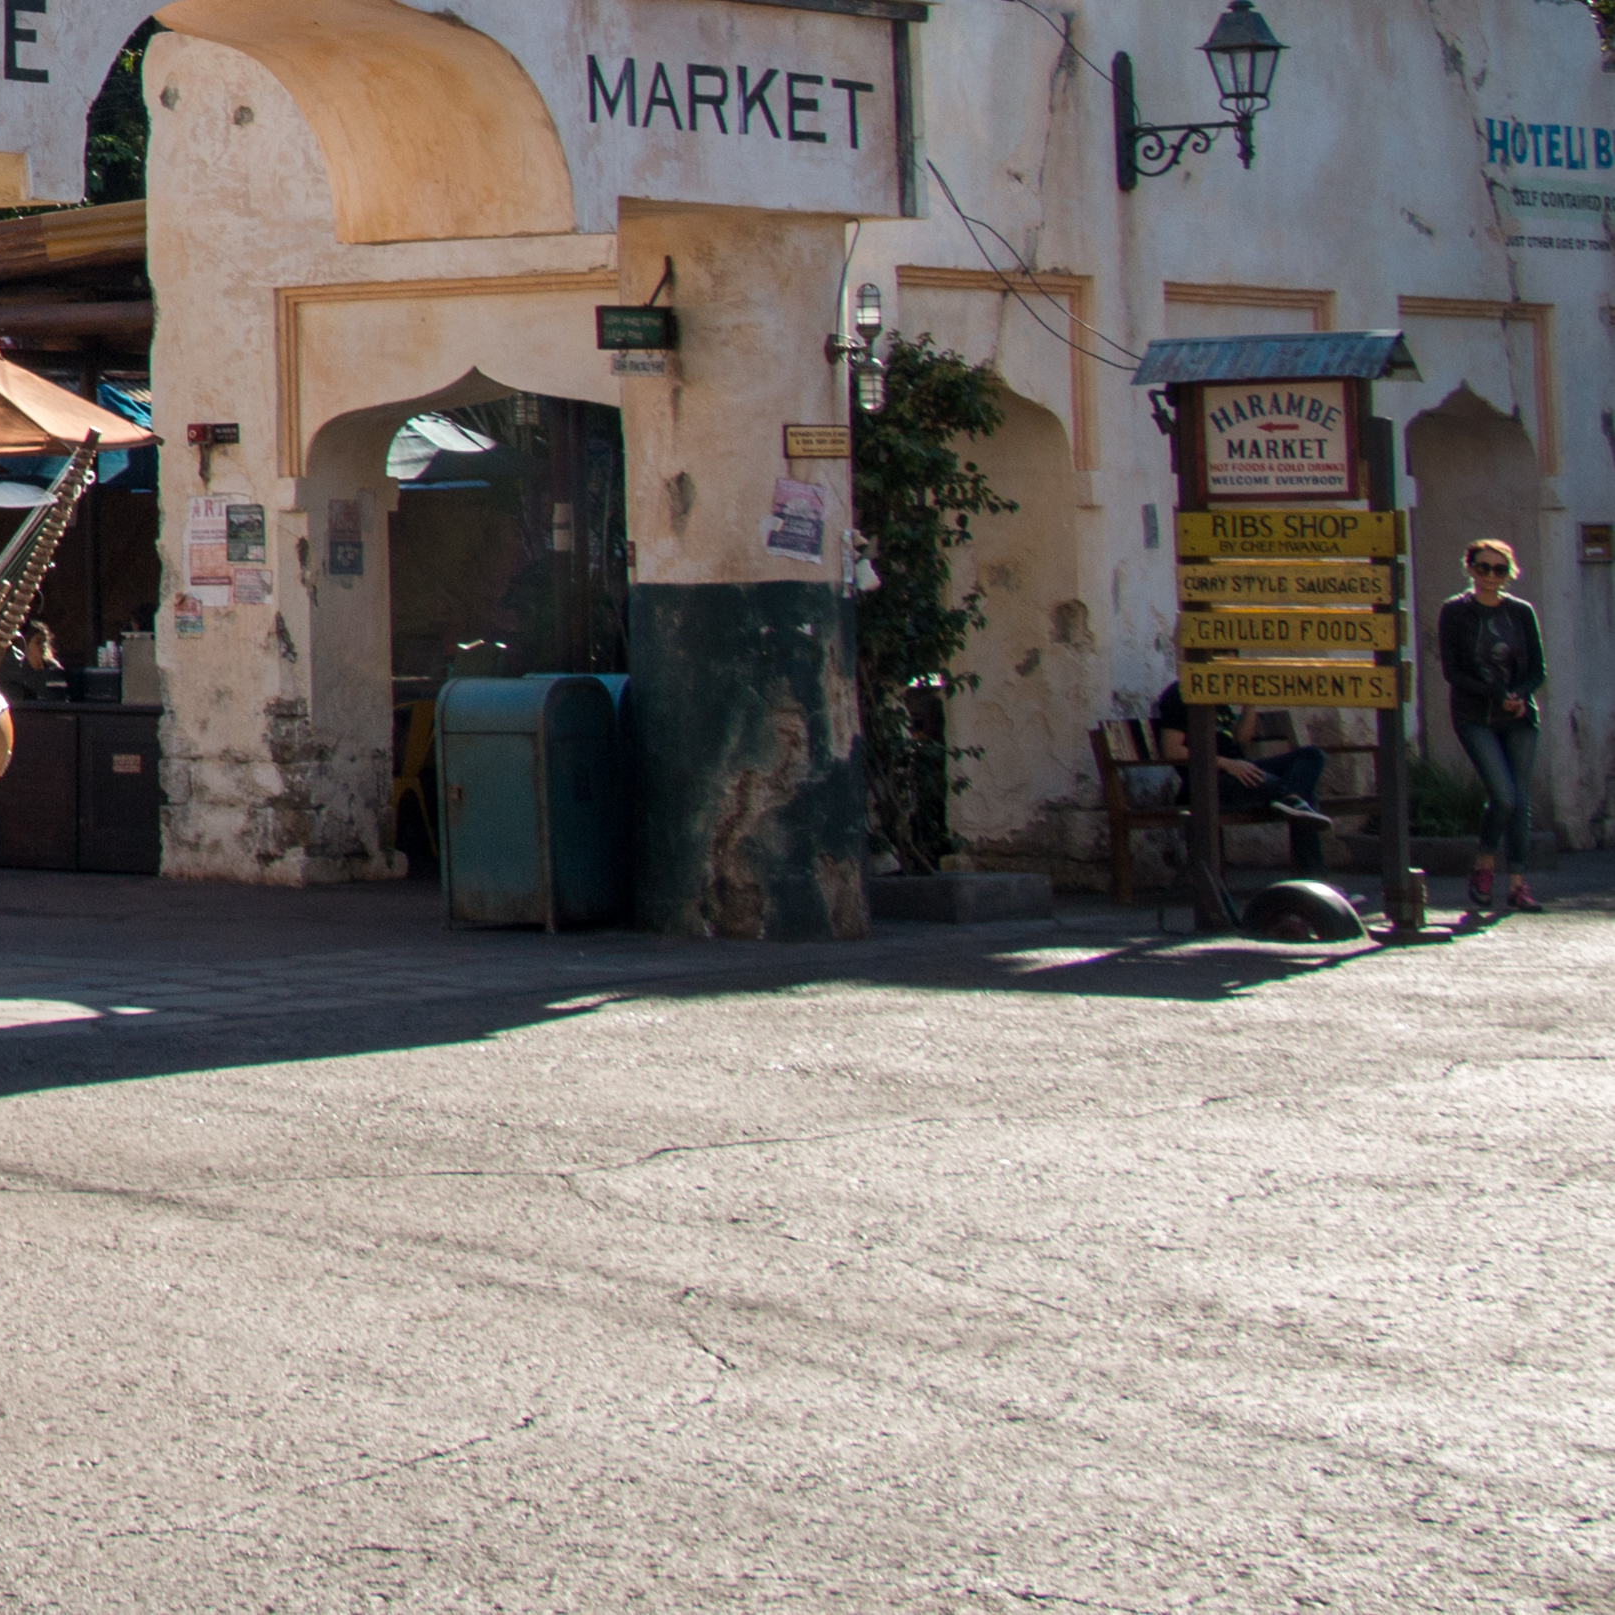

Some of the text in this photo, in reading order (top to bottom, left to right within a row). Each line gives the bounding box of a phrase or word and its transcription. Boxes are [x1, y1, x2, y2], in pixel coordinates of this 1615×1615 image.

[586, 53, 875, 150] MARKET
[1485, 117, 1588, 170] HOTELI
[1512, 186, 1538, 206] SELF
[1541, 191, 1602, 212] CONTAINED
[1209, 392, 1342, 433] HARAMBE
[1226, 439, 1327, 459] MARKET
[1210, 463, 1229, 472] HOT
[1232, 463, 1266, 472] FOODS
[1277, 463, 1305, 473] COLD
[1308, 463, 1346, 473] DRINKS
[1211, 476, 1345, 486] WELCOME EVERYBODY
[1212, 515, 1358, 539] RIBS SHOP
[1219, 540, 1341, 553] BY CHEF MWANGA
[1184, 576, 1382, 594] CURRY STYLE SAUSAGES
[1197, 619, 1290, 641] GRILLED
